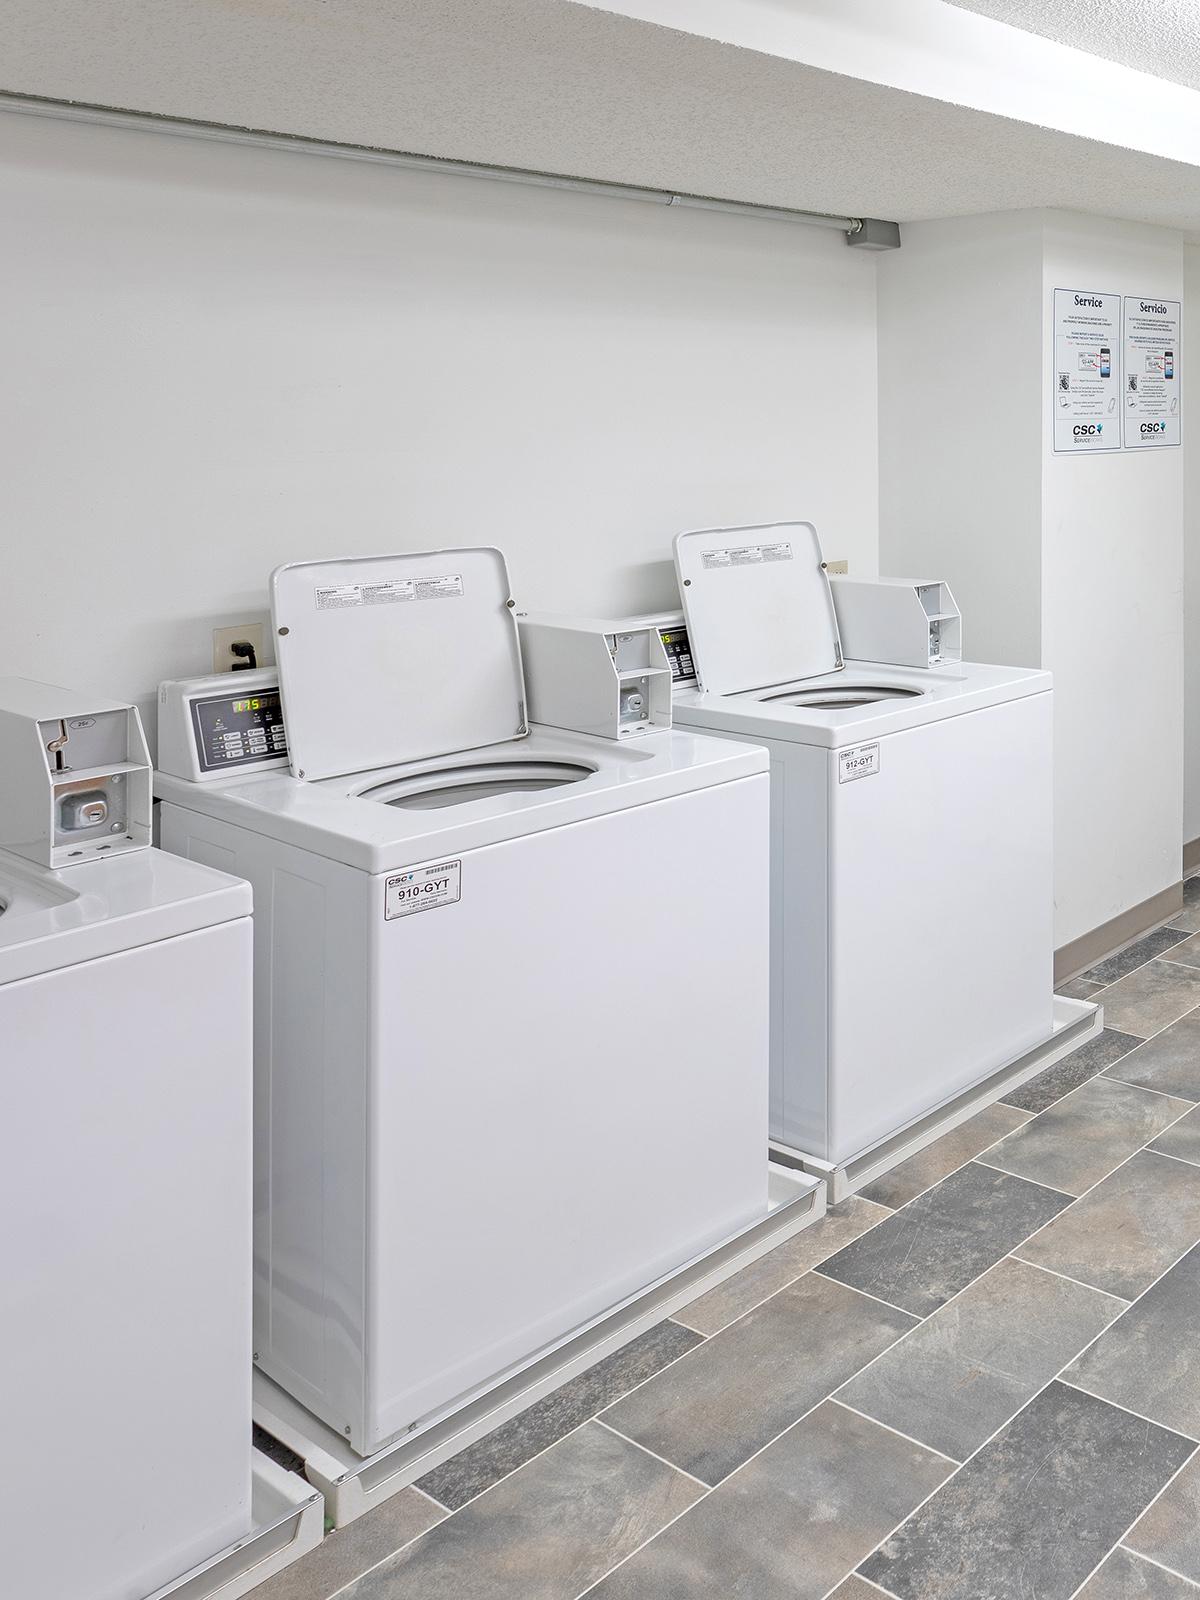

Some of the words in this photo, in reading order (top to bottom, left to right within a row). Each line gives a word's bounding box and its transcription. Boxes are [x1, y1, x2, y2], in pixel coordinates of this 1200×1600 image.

[1074, 295, 1103, 308] Service
[1140, 301, 1167, 314] Servicio
[1073, 425, 1096, 435] CSC
[1140, 422, 1160, 432] CSC
[846, 755, 874, 770] 912-GYT
[388, 876, 408, 885] CSC
[398, 878, 450, 900] 910-GYT
